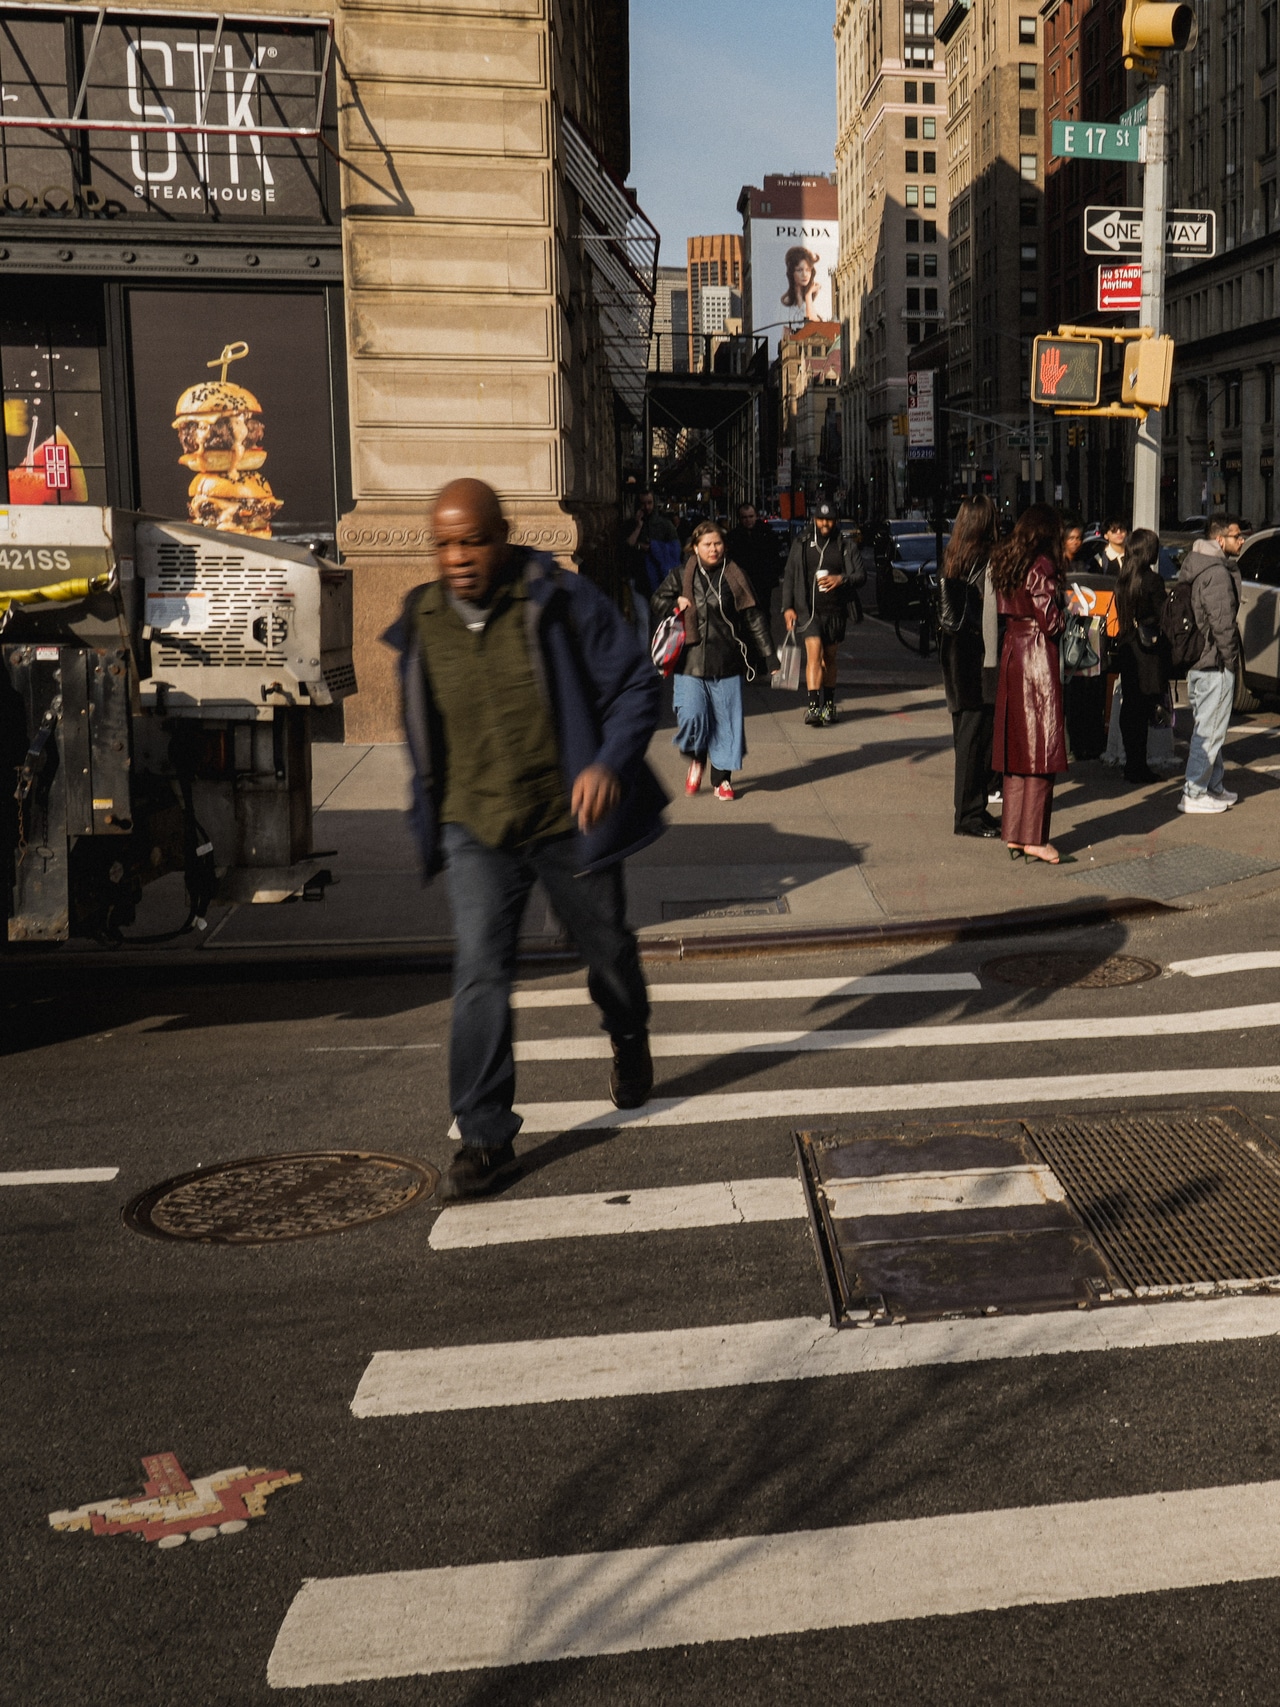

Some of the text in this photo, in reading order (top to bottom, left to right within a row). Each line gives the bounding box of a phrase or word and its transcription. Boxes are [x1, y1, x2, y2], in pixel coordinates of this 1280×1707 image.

[127, 40, 275, 185] STK
[1064, 126, 1130, 154] E 17 St
[134, 184, 276, 203] STEAKHOUSE
[776, 226, 830, 238] PRADA
[1103, 222, 1202, 242] ONE WAY
[1102, 269, 1141, 279] NO STANDI
[1102, 280, 1133, 291] Anytime
[0, 549, 71, 570] 421SS
